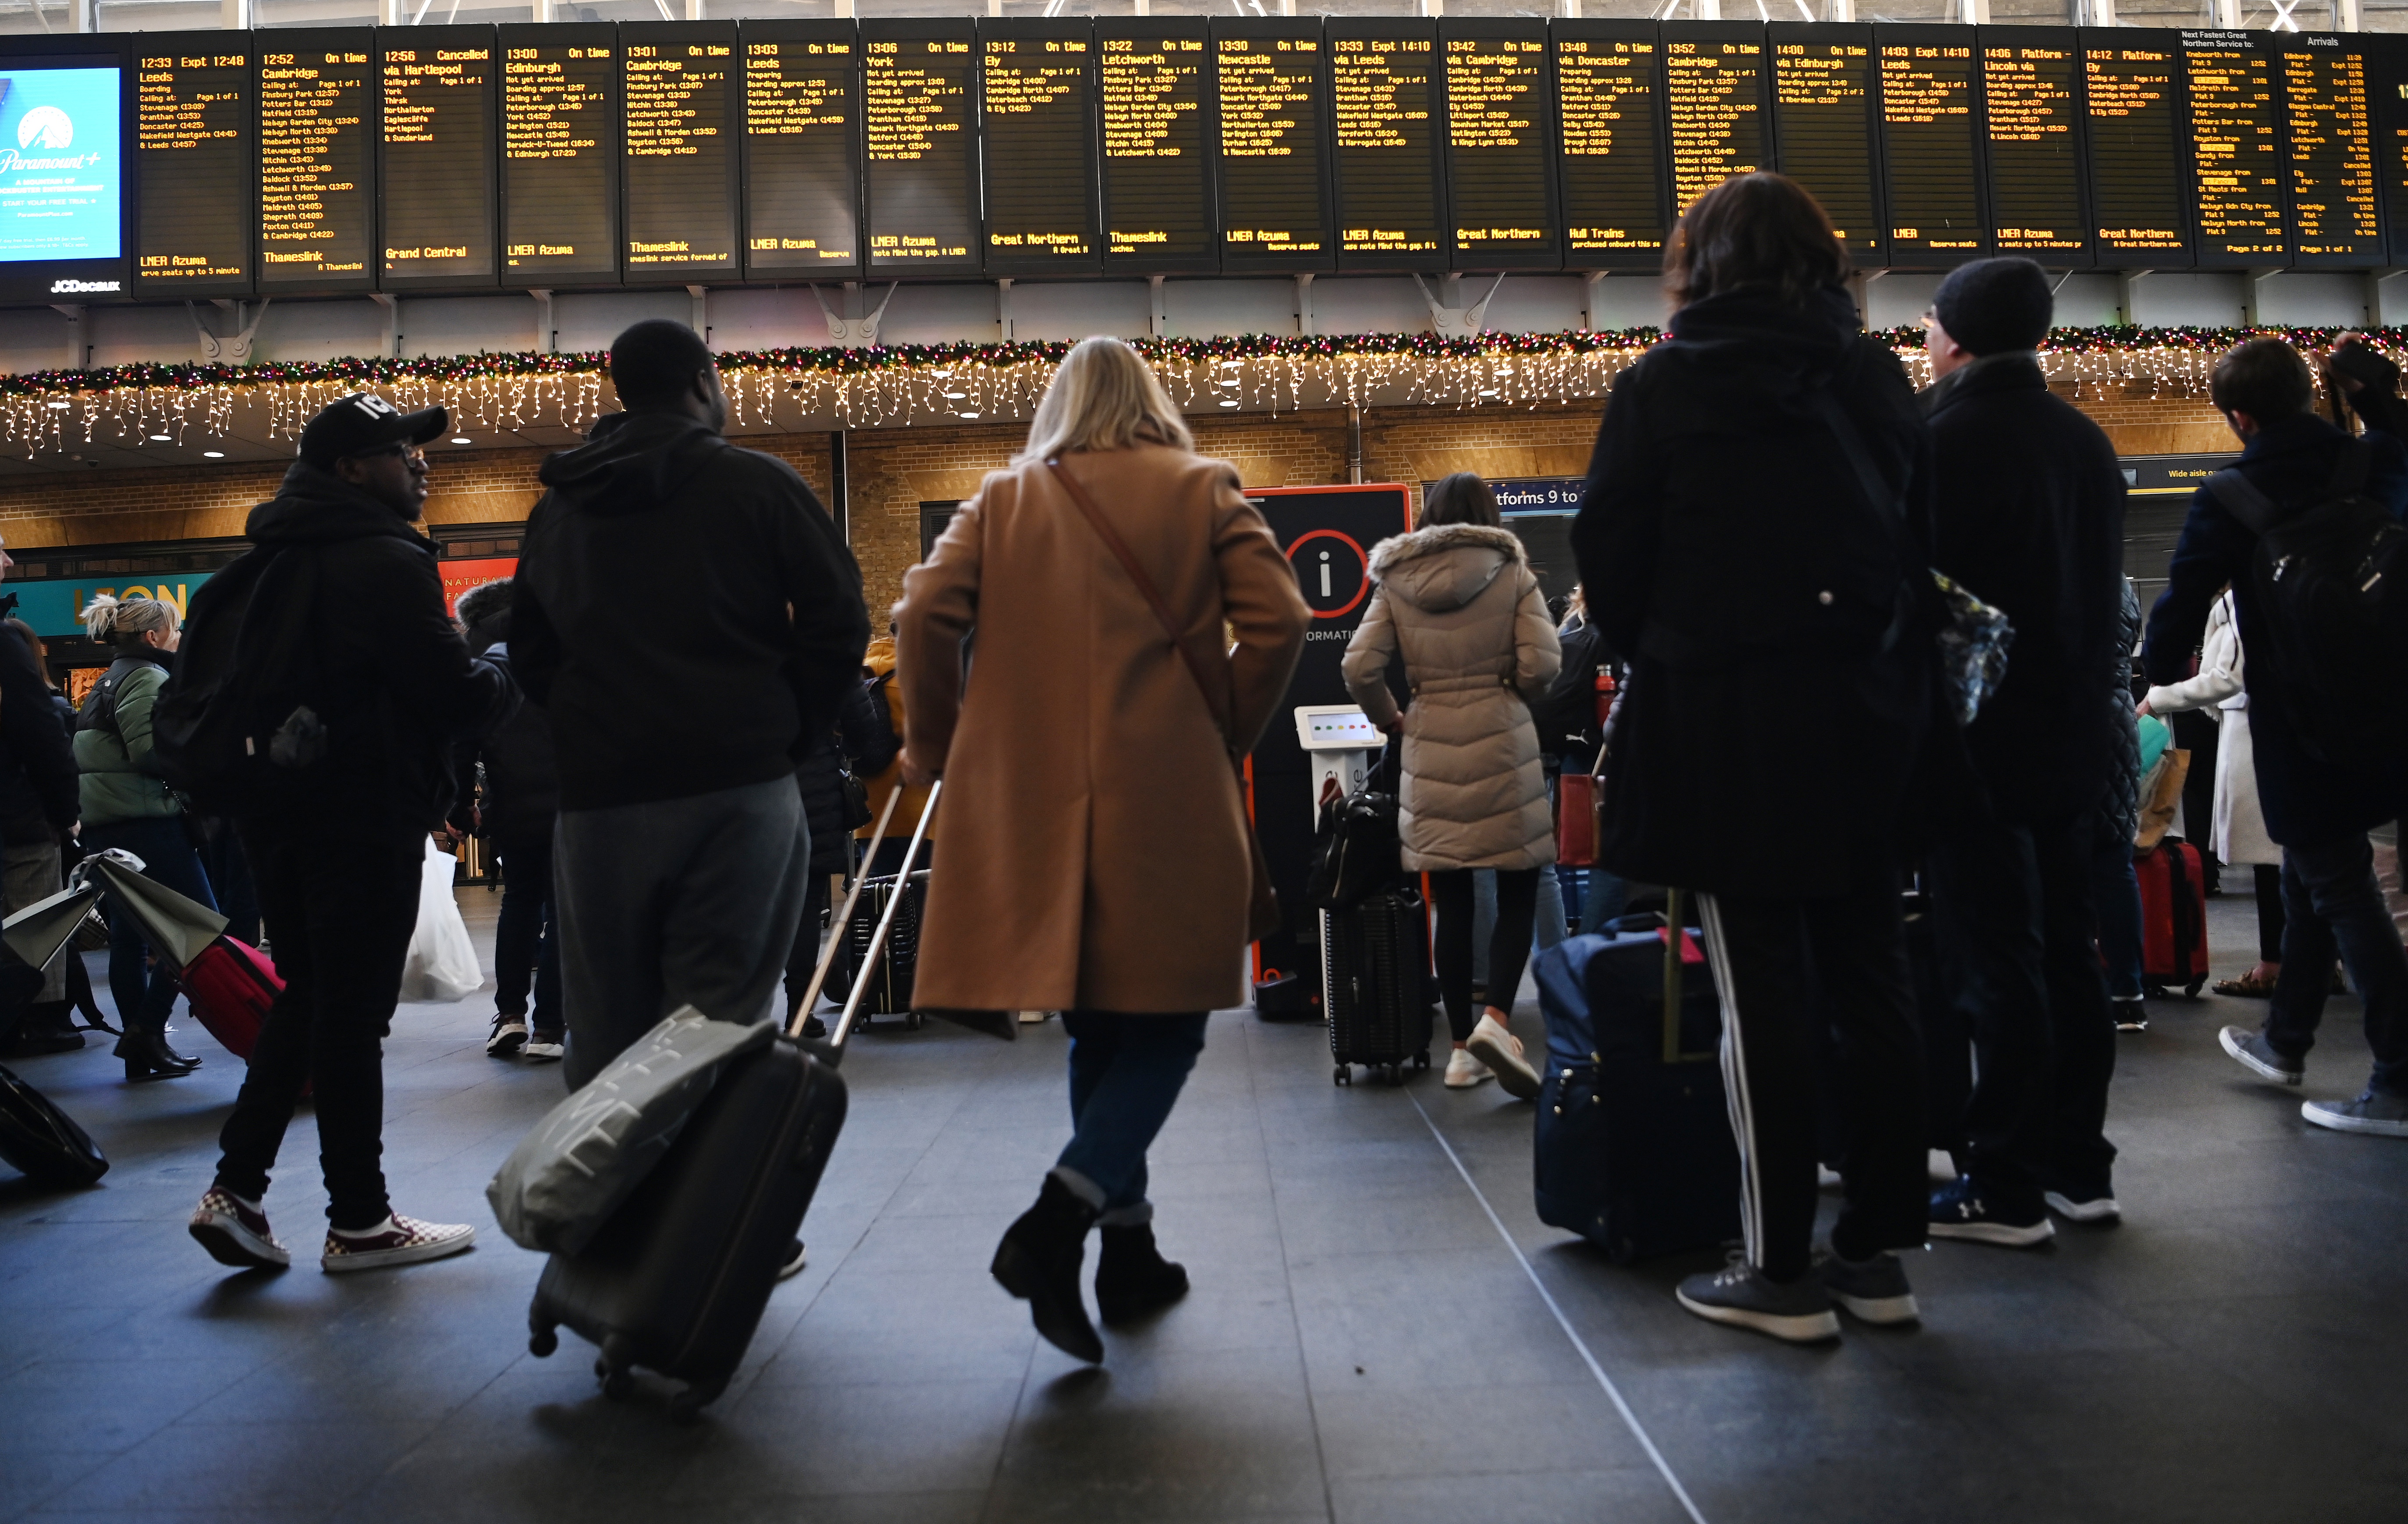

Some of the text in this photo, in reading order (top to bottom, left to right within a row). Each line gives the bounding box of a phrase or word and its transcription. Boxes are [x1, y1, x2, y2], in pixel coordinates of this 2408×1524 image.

[1104, 41, 1202, 51] 13:22 On time
[1219, 41, 1316, 51] 13:30 On time
[2307, 37, 2338, 46] Arrivals
[628, 46, 729, 57] 13:01 On time
[748, 44, 849, 55] 13:03 On time
[868, 43, 968, 53] 13:06 On time
[987, 42, 1086, 52] 13:12 On time
[1335, 42, 1430, 53] 13:33 Expt 14:10
[1448, 42, 1542, 52] 13:42 On time
[1560, 43, 1652, 53] 13:48 On time
[1668, 44, 1759, 53] 13:52 On time
[1777, 45, 1866, 55] 14:00 On time
[386, 49, 488, 61] 12:56 Cancelled
[508, 48, 609, 59] 13:00 On time
[1882, 47, 1969, 58] 14:03 Expt 14:10
[1985, 49, 2062, 58] 14:06 Platform
[2087, 50, 2162, 60] 14:12 Platform
[142, 56, 244, 68] 12:33 Expt 12:48
[264, 53, 366, 64] 12:52 On time
[747, 58, 779, 68] Leeds
[867, 57, 893, 67] York
[985, 56, 1000, 67] Ely
[1102, 54, 1165, 65] Letchworth
[1218, 55, 1270, 64] Newcastle
[1334, 55, 1385, 64] via Leeds
[1447, 55, 1517, 66] via Cambridge
[1559, 56, 1630, 66] via Doncaster
[1668, 57, 1717, 67] Cambridge
[1777, 58, 1843, 69] via Edinburgh
[506, 62, 561, 74] Edinburgh
[627, 60, 682, 71] Cambridge
[1882, 60, 1910, 69] Leeds
[1985, 61, 2035, 71] Lincoln via
[2086, 63, 2100, 73] Ely
[263, 68, 318, 79] Cambridge
[384, 64, 462, 76] via Hartlepool
[140, 72, 173, 82] Leeds
[747, 71, 781, 80] Preparing
[140, 85, 171, 93] Boarding
[384, 106, 435, 114] Northallerton
[384, 115, 429, 124] Eaglescliffe
[1451, 130, 1487, 138] Watlington
[507, 140, 568, 149] Berwick-U-Tweed
[0, 149, 101, 174] Paramount+
[1110, 231, 1167, 242] Thameslink
[1227, 231, 1290, 241] LNER Azuma
[1343, 230, 1405, 240] LNER Azuma
[1457, 229, 1540, 239] Great Northern
[1570, 229, 1624, 238] Hull Trains
[1894, 229, 1917, 238] LNER
[1998, 229, 2053, 238] LNER Azuma
[2099, 229, 2174, 238] Great Northern
[751, 238, 816, 250] LNER Azuma
[871, 236, 936, 247] LNER Azuma
[991, 233, 1078, 245] Great Northern
[508, 245, 573, 256] LNER Azuma
[630, 241, 689, 252] Thameslink
[264, 251, 323, 262] Thameslink
[386, 246, 467, 259] Grand Central
[141, 256, 207, 266] LNER Azuma
[50, 279, 121, 293] JCDecaux
[1495, 490, 1577, 505] tforms 9 to
[74, 584, 186, 625] LN
[1306, 630, 1357, 641] ORMATI
